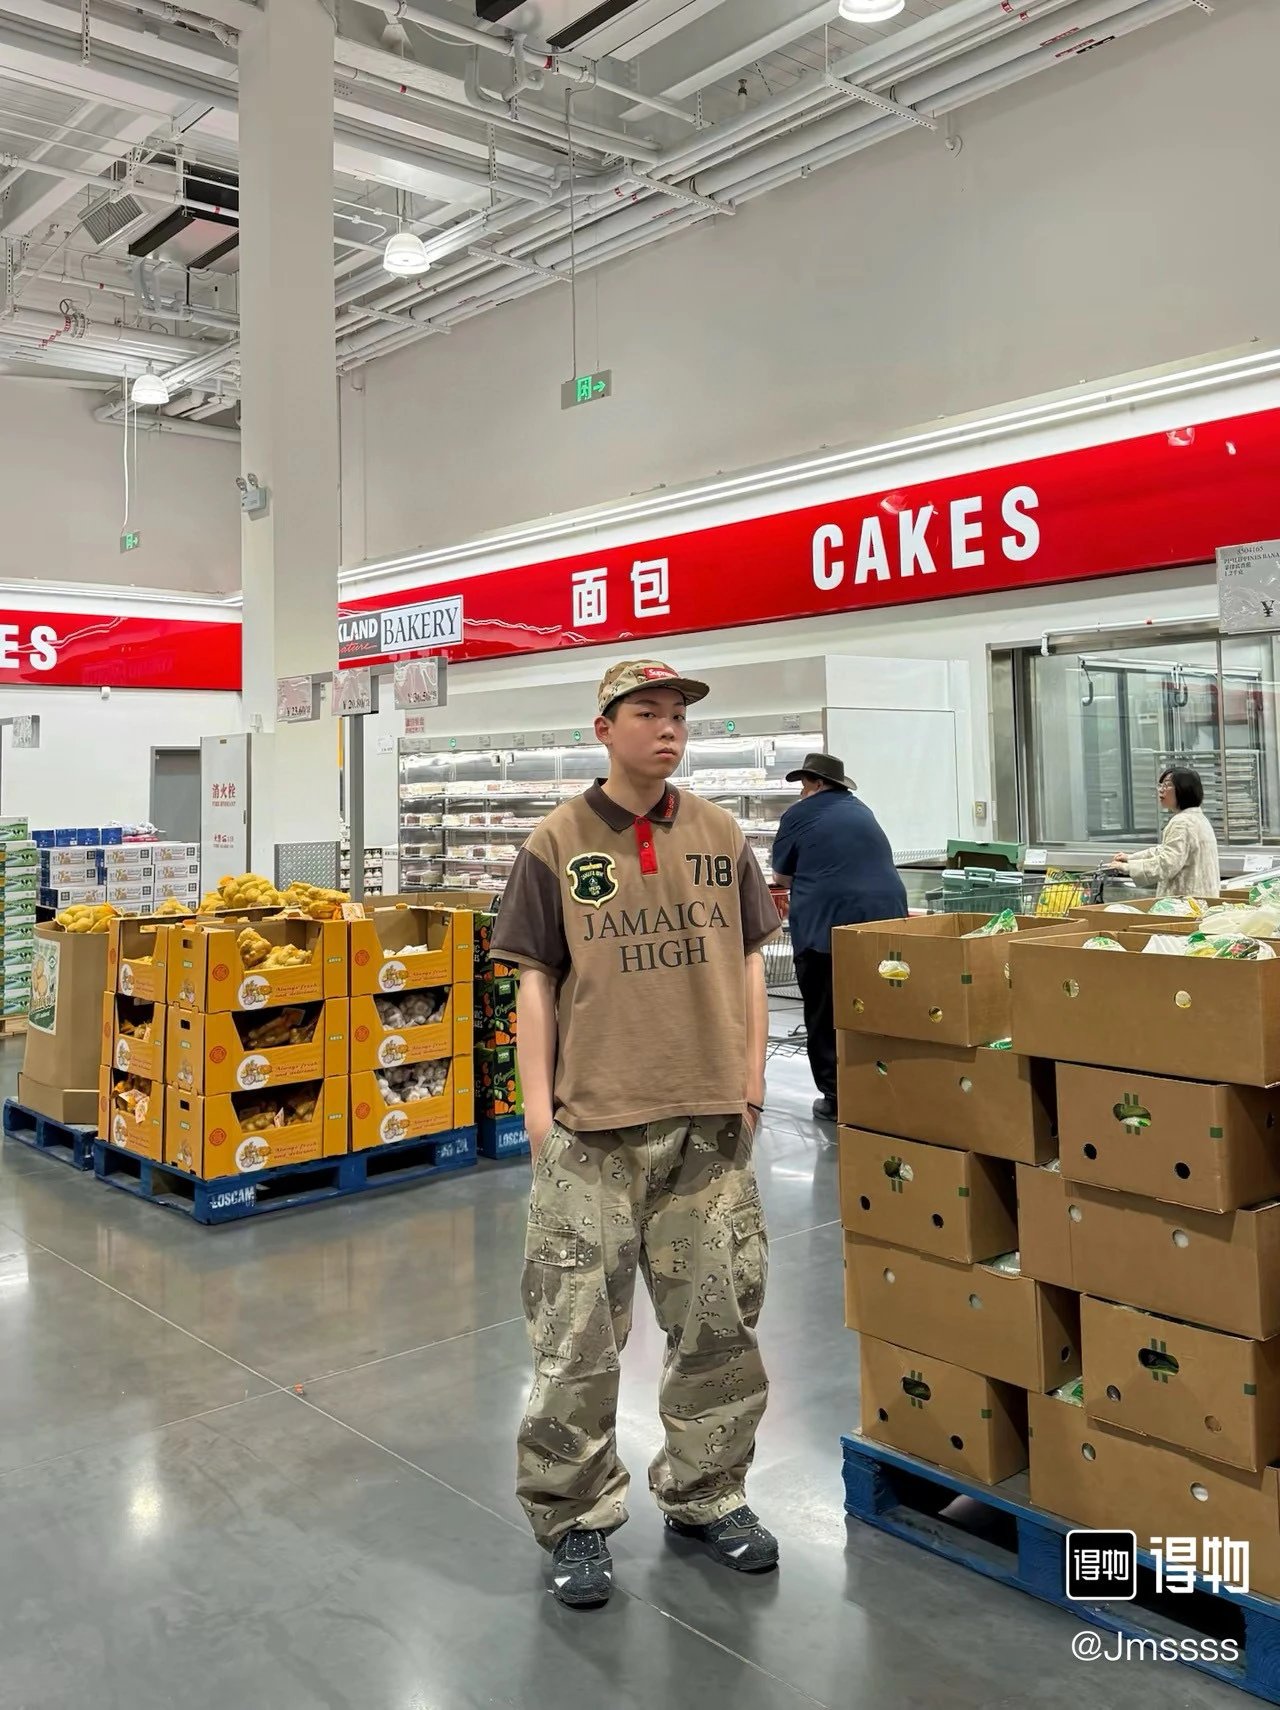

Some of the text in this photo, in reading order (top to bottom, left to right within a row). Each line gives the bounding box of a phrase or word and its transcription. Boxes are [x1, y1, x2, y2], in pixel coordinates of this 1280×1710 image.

[812, 485, 1040, 591] CAKES
[571, 557, 671, 628] 面包
[383, 606, 459, 645] BAKERY
[686, 854, 733, 887] 718
[583, 901, 730, 941] JAMAICA
[619, 936, 709, 973] HIGH
[209, 1186, 255, 1209] LOSCAM
